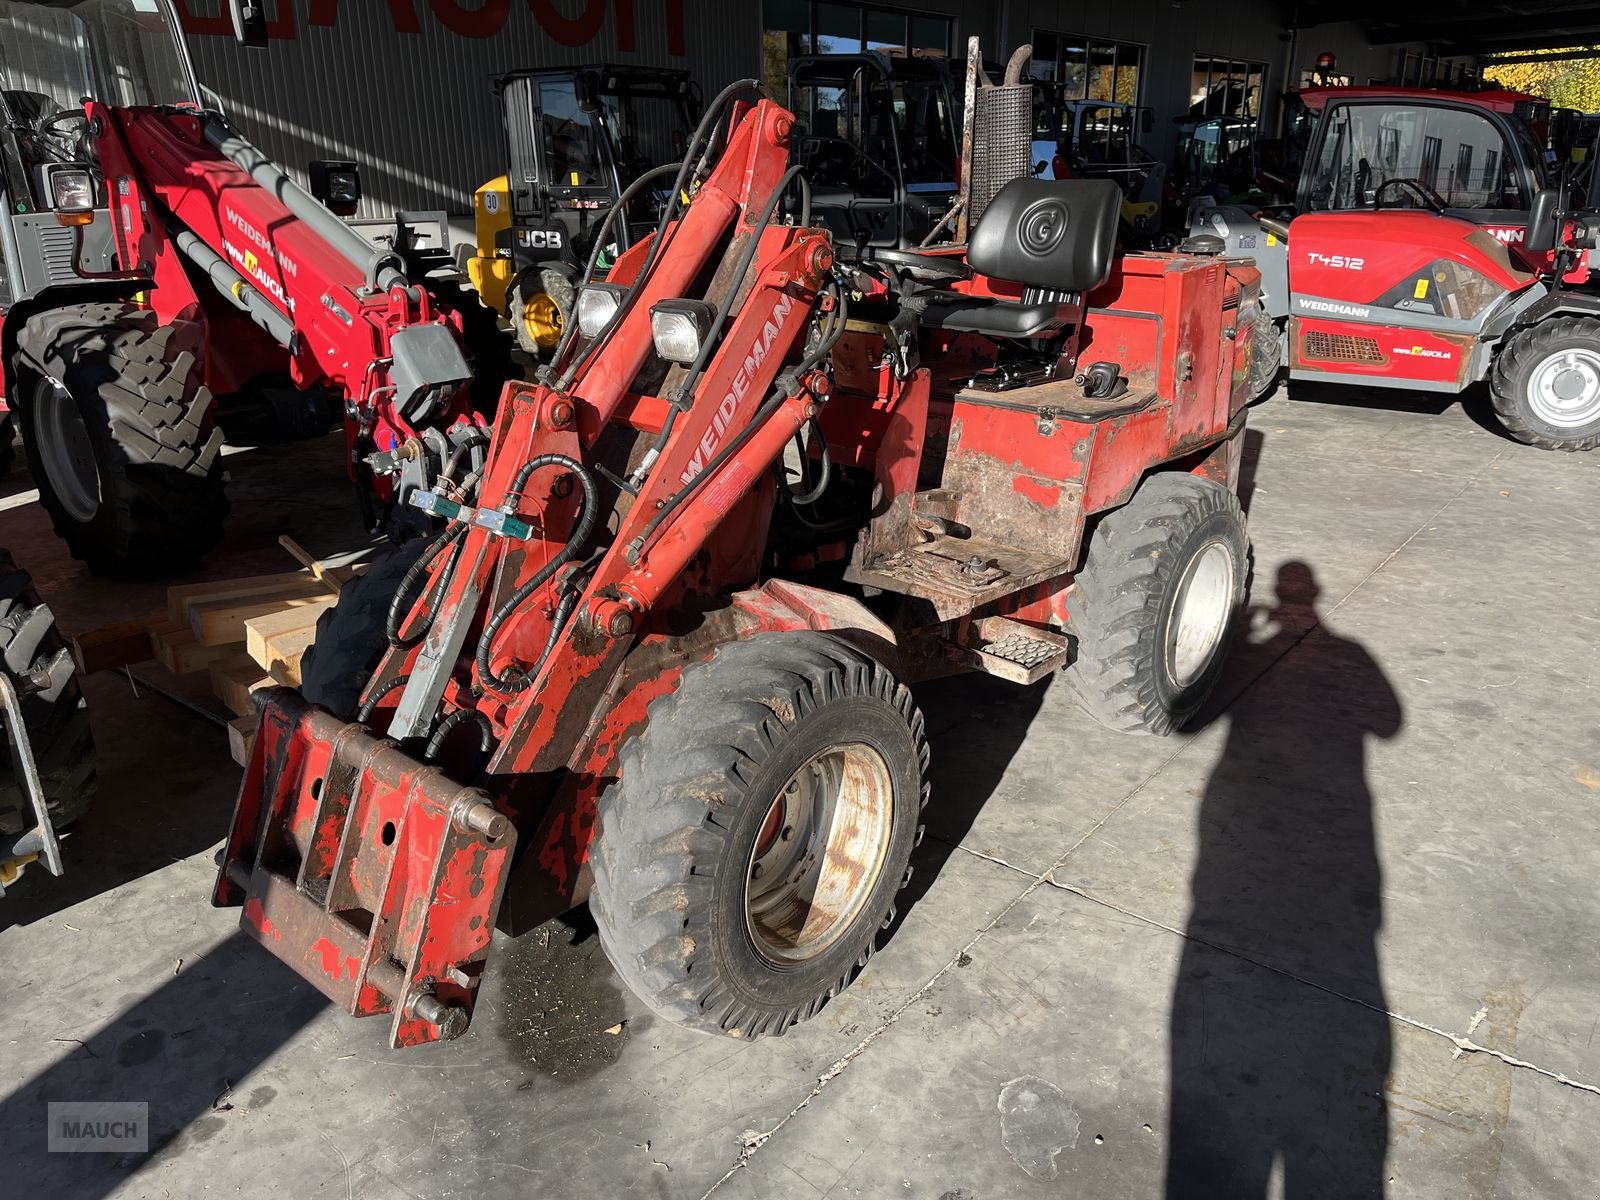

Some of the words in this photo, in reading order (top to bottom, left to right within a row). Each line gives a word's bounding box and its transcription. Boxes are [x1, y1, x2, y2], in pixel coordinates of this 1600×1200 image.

[486, 194, 497, 209] 30
[225, 205, 297, 278] WEIDEMANN
[519, 230, 562, 249] JCB
[1307, 252, 1365, 271] T4512
[1299, 299, 1370, 318] WEIDEMANN
